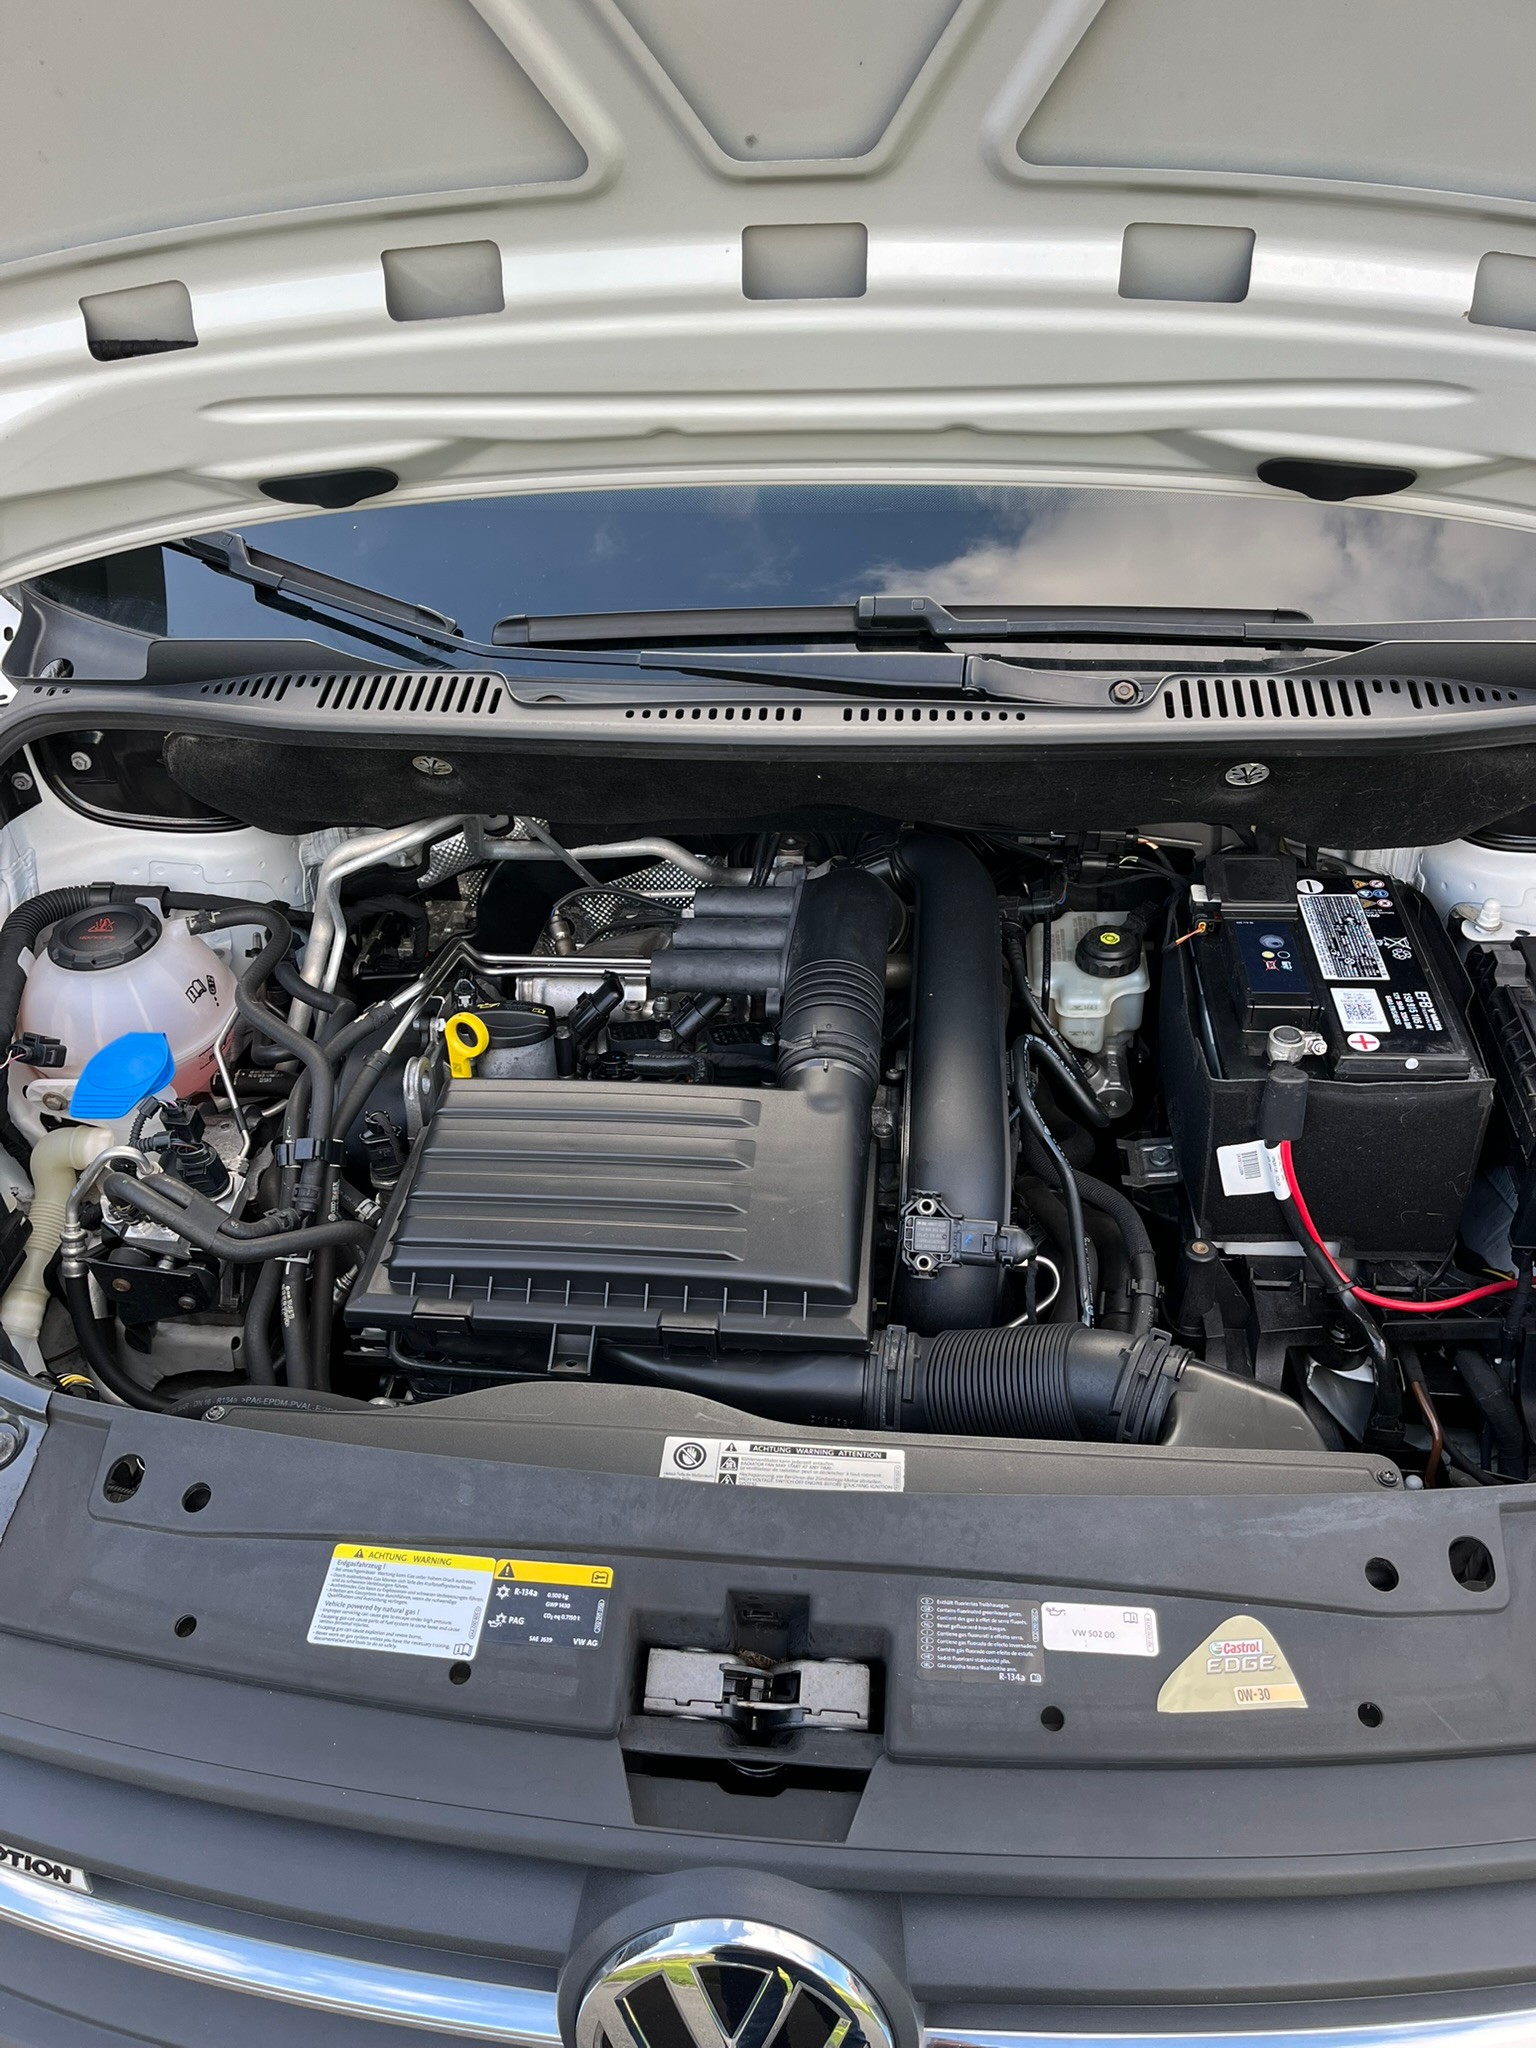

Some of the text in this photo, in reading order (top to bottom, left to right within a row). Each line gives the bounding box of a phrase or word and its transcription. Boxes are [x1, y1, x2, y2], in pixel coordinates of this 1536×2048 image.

[1414, 991, 1433, 1008] EFB
[752, 1445, 882, 1458] ACHTUNG WARNING ATTENTION
[368, 1551, 452, 1566] ACHTUNG WARNING
[514, 1588, 538, 1597] R-134a
[346, 1602, 373, 1611] powered
[508, 1617, 525, 1625] PAG
[1072, 1628, 1115, 1639] VW 502 00
[573, 1638, 586, 1646] VW
[1224, 1640, 1260, 1654] Castrol
[1206, 1654, 1276, 1674] EDGE
[999, 1672, 1025, 1681] R-134a
[1237, 1688, 1271, 1702] 0W-30
